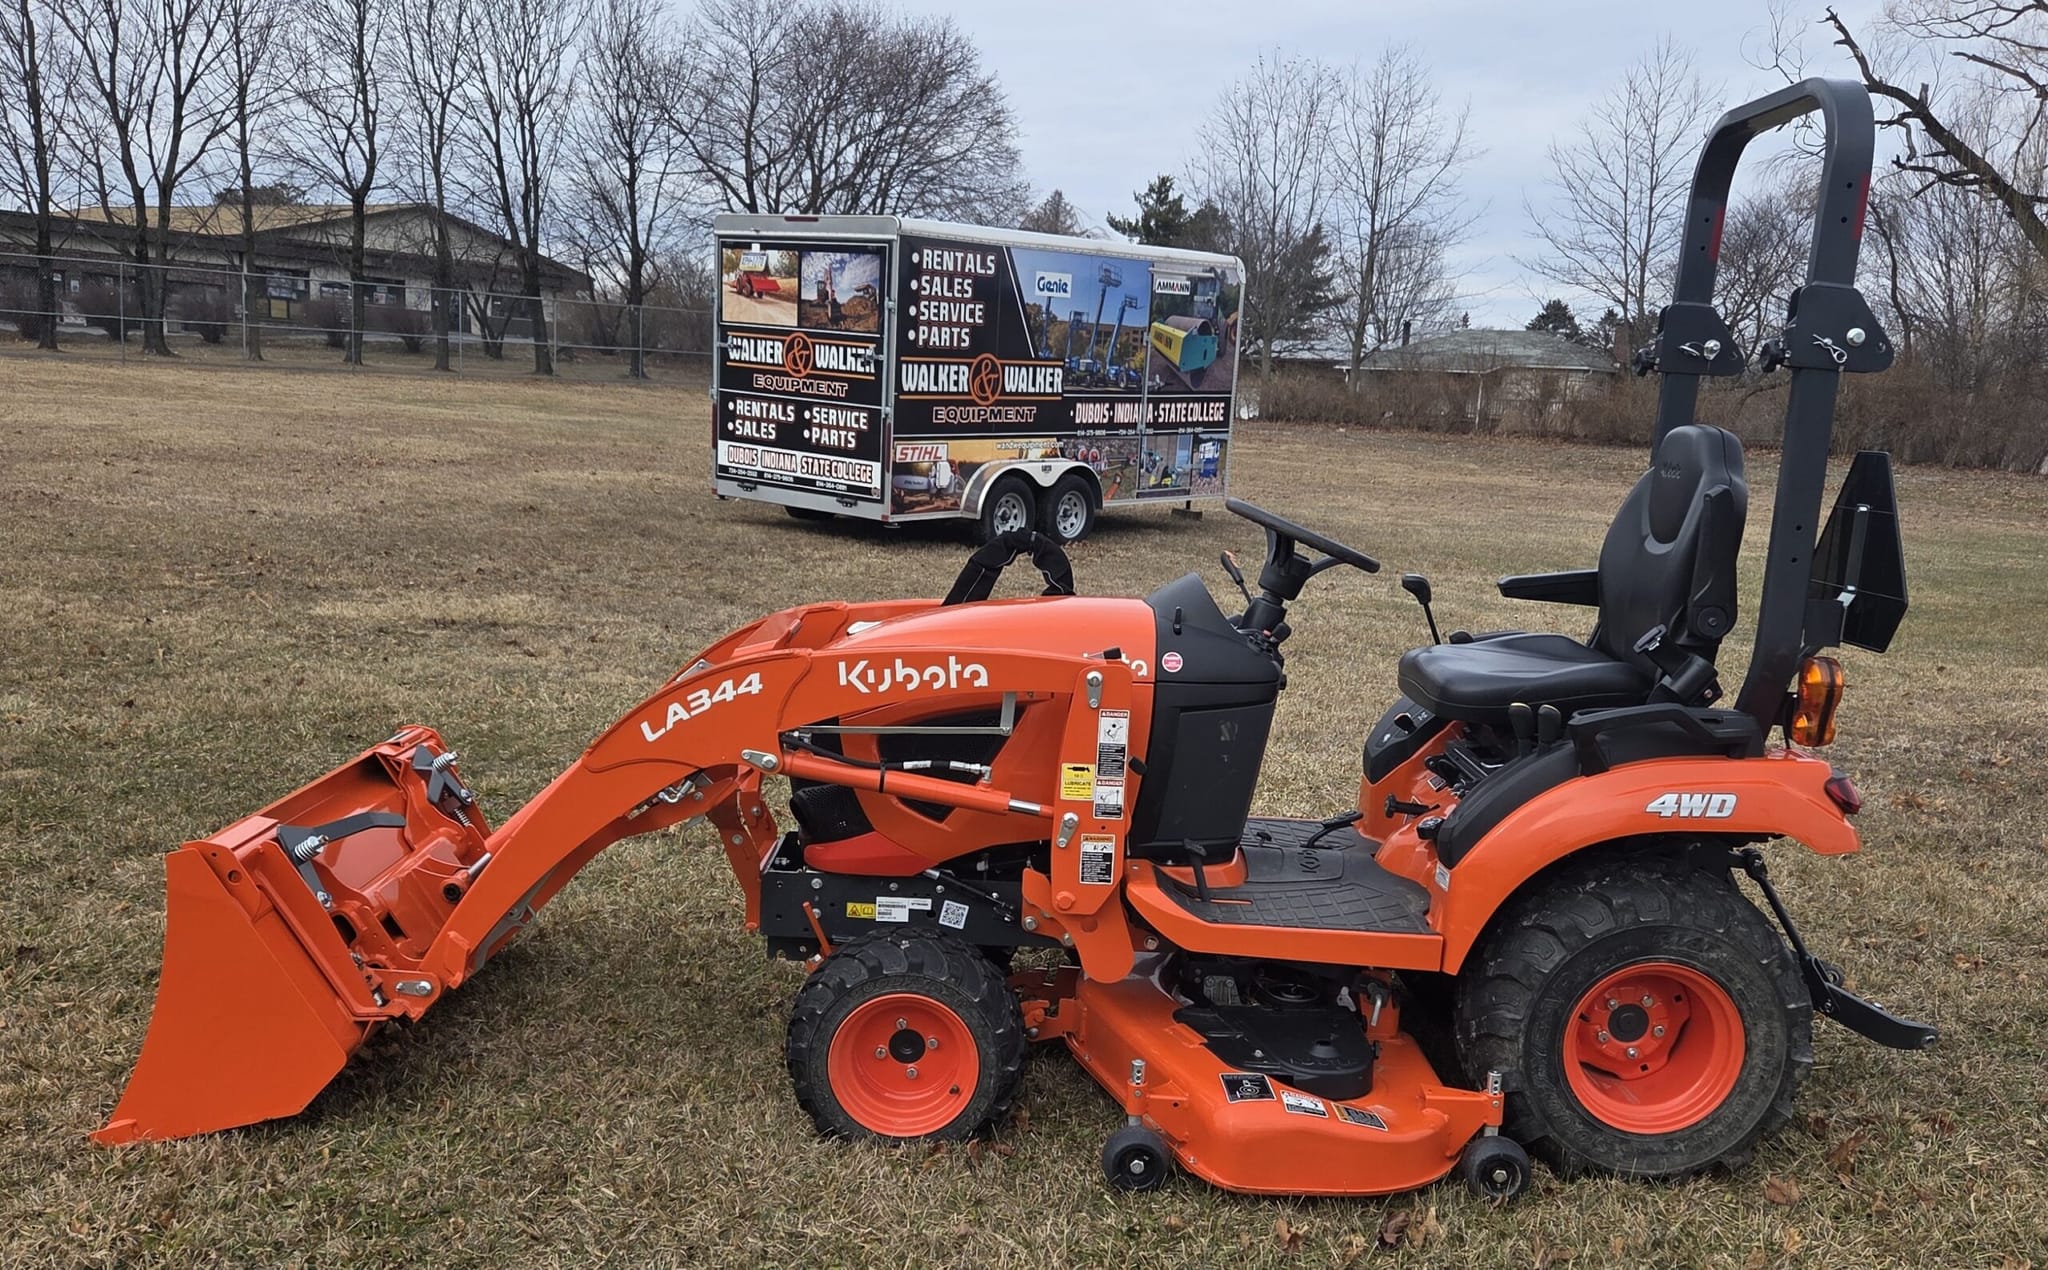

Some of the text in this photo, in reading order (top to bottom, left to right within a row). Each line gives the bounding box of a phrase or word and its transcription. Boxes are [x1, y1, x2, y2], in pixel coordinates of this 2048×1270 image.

[922, 249, 996, 275] RENTALS
[920, 276, 972, 298] SALES
[1037, 276, 1068, 294] Genie
[1156, 280, 1190, 294] AMMANN
[919, 301, 984, 324] SERVICE
[918, 326, 970, 347] PARTS
[728, 336, 783, 364] WALKER
[787, 337, 809, 377] &
[753, 373, 848, 397] EQUIPMENT
[901, 359, 1063, 401] WALKER & WALKER
[736, 400, 795, 422] RENTALS
[812, 407, 868, 429] SERVICE
[933, 406, 1036, 424] EQUIPMENT
[1075, 402, 1109, 424] DUBOIS
[1158, 402, 1186, 423] STATE
[1187, 402, 1225, 422] COLLEGE
[735, 420, 776, 439] SALES
[811, 428, 856, 448] PARTS
[727, 445, 758, 465] DUBOIS
[761, 450, 797, 473] INDIANA
[801, 456, 831, 479] STATE
[831, 460, 873, 483] COLLEGE
[898, 445, 943, 461] STIHL
[838, 655, 989, 693] Kubota
[640, 672, 763, 742] LA344
[1645, 793, 1738, 817] 4WD
